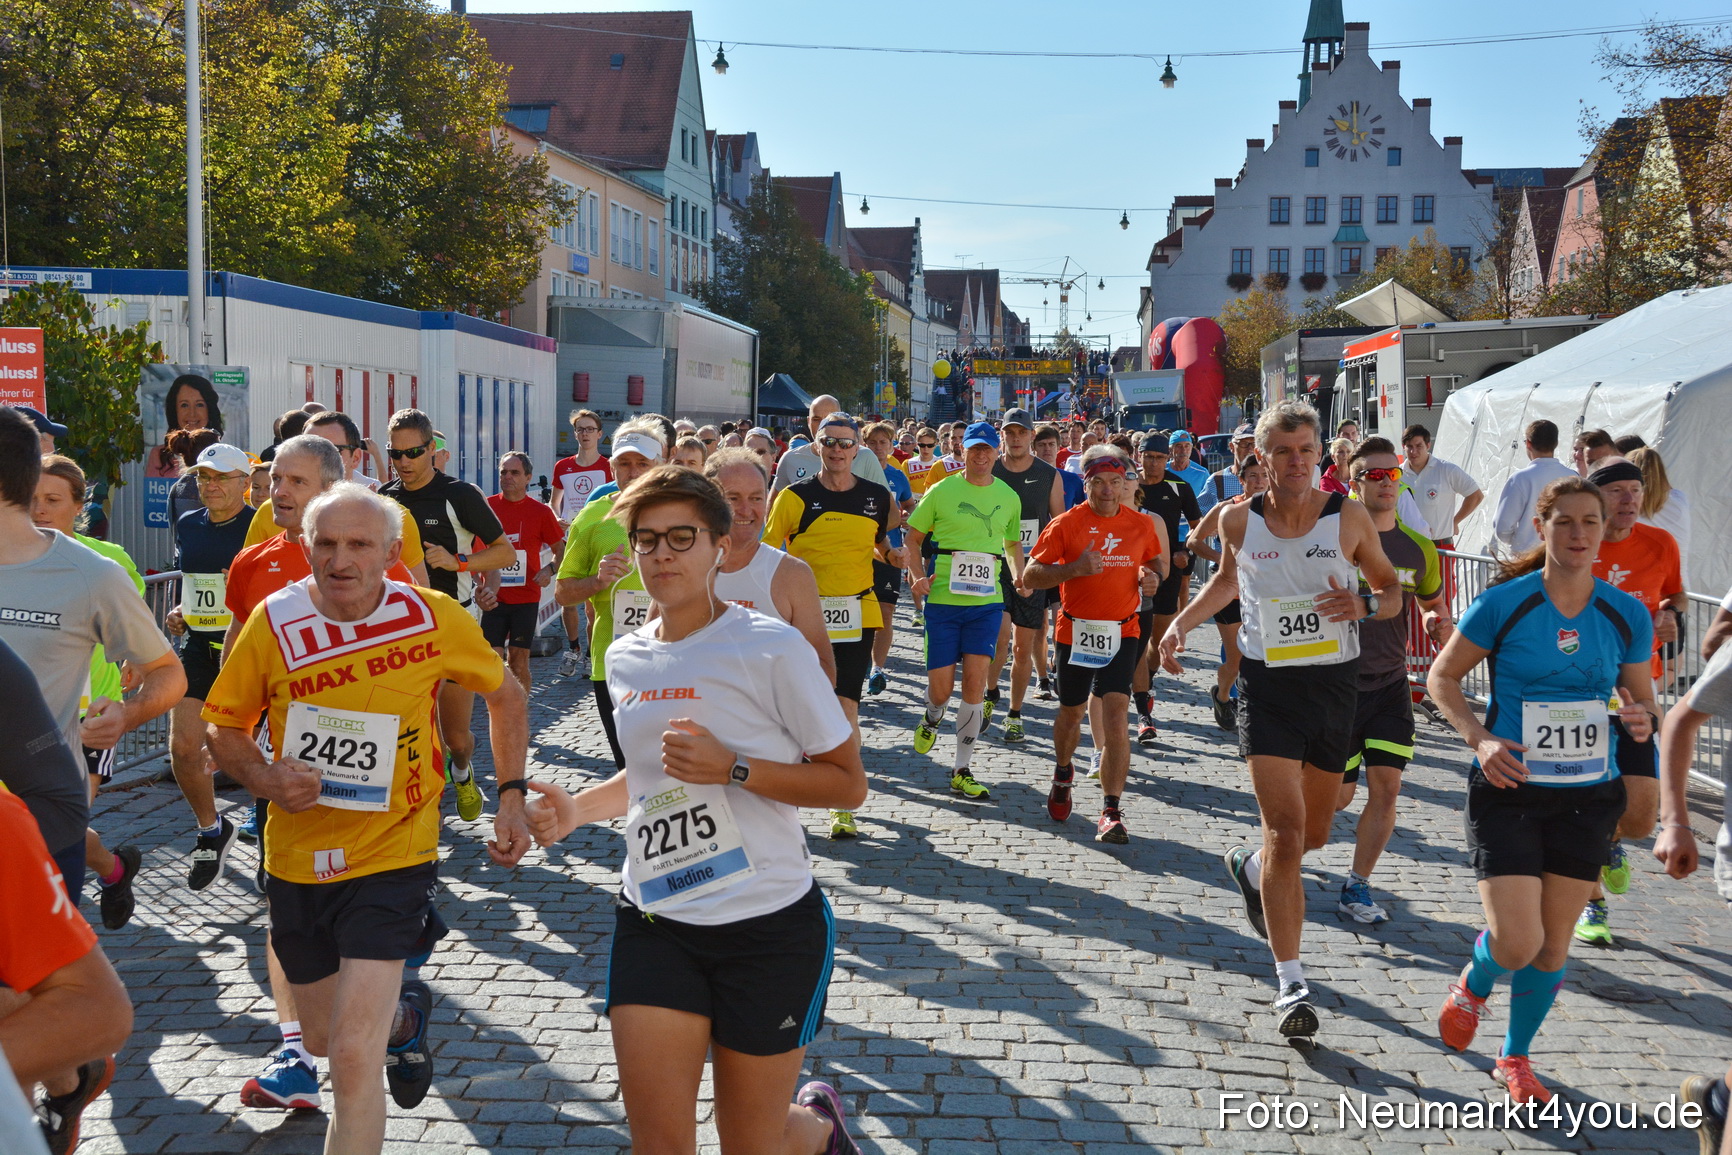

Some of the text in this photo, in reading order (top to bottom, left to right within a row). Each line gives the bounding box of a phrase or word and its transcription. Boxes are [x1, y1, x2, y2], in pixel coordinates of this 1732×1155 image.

[0, 338, 36, 354] luss
[1005, 363, 1039, 371] START
[22, 388, 35, 398] für
[149, 481, 170, 495] Hel
[1020, 530, 1032, 541] 07
[1251, 551, 1279, 560] LGO
[958, 563, 990, 579] 2138
[195, 590, 216, 608] 70
[1280, 599, 1314, 611] BOCK
[0, 607, 62, 626] BOCK
[823, 609, 850, 624] 320
[1278, 612, 1320, 637] 349
[1080, 632, 1112, 650] 2181
[289, 642, 441, 699] MAX BÖGL
[639, 688, 702, 703] KLEBL
[204, 702, 234, 716] egl.de
[1549, 709, 1586, 719] BOCK
[318, 715, 365, 731] BOCK
[1537, 724, 1598, 749] 2119
[298, 732, 377, 770] 2423
[326, 770, 359, 781] Neumarkt
[1554, 763, 1583, 775] Sonja
[320, 783, 357, 798] ohann
[645, 786, 688, 812] BOCK
[638, 803, 716, 861] 2275
[653, 848, 707, 872] PARTL Neumarkt
[666, 866, 715, 892] Nadine
